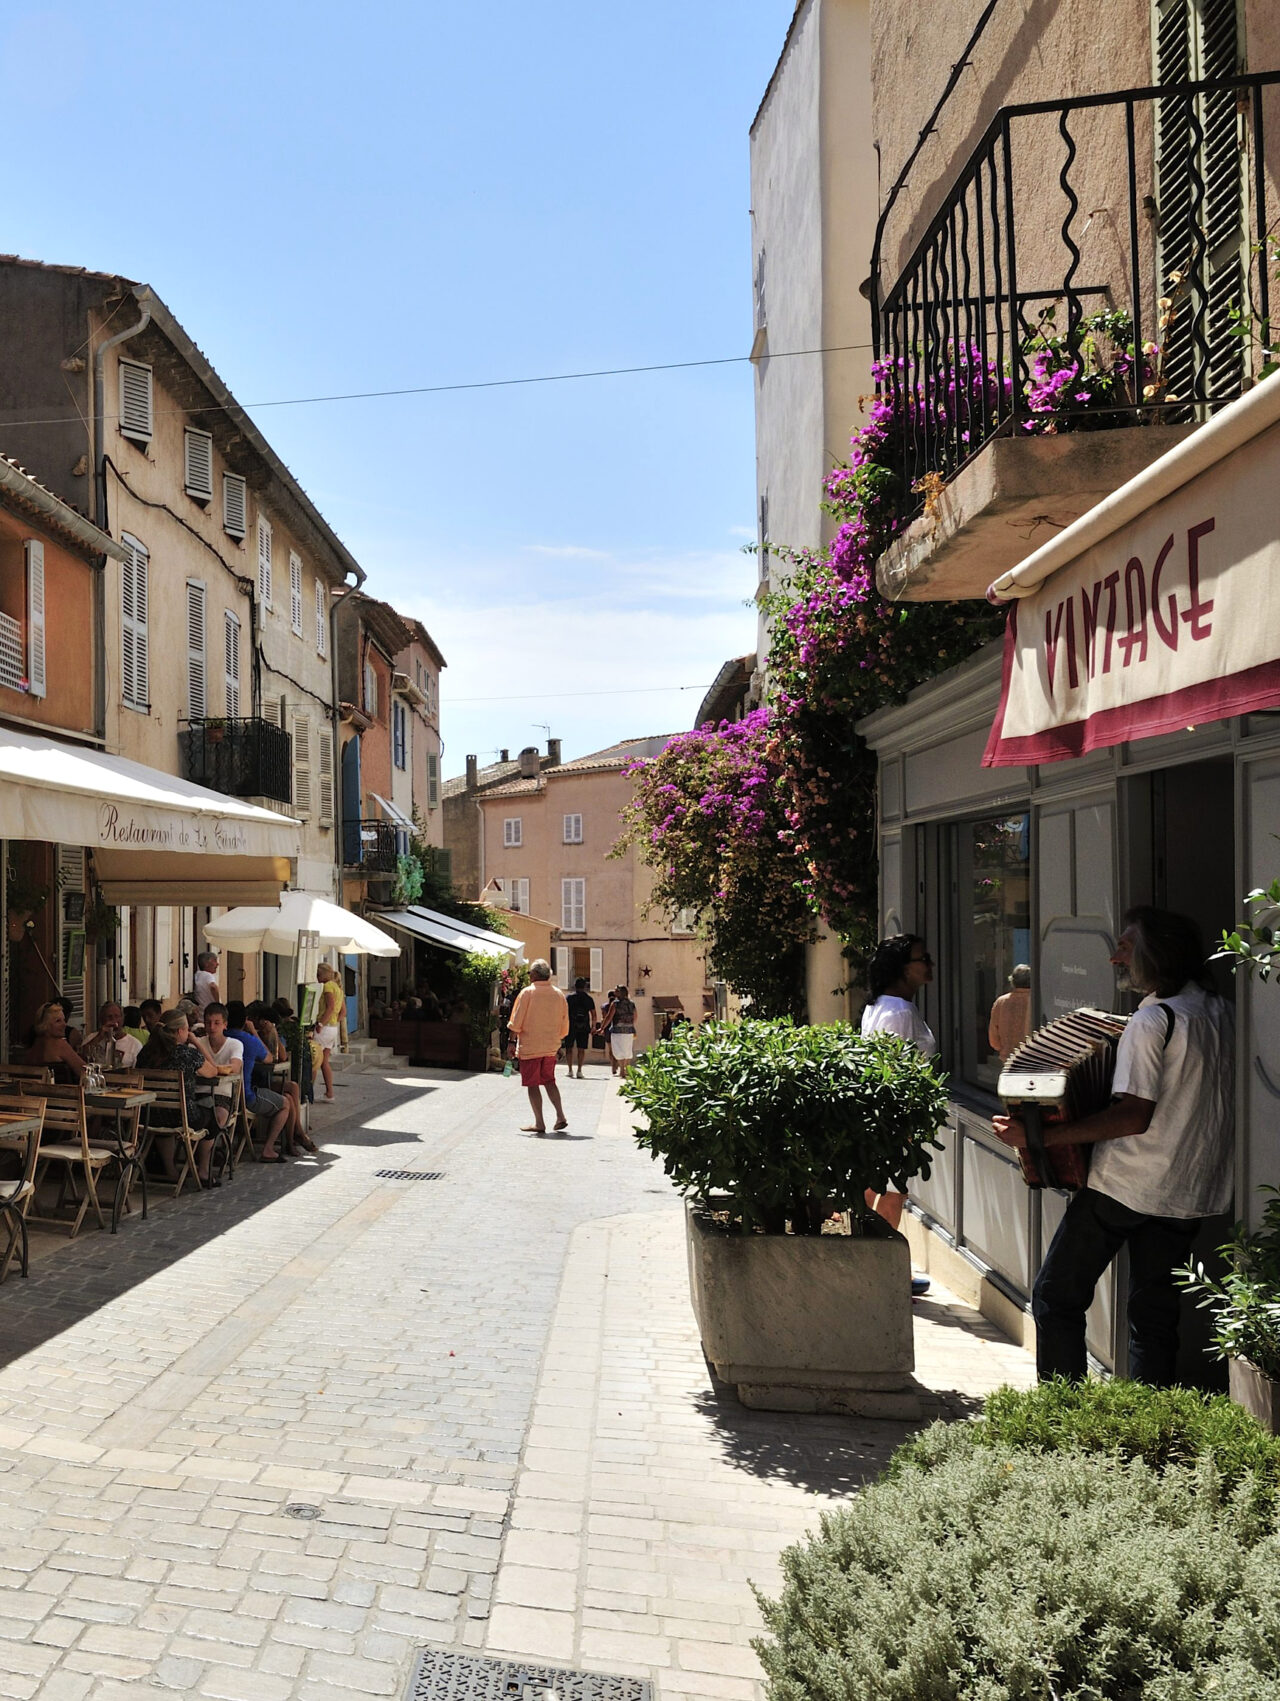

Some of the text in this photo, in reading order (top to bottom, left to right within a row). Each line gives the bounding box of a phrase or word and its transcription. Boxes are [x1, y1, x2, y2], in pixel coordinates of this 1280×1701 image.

[1045, 517, 1216, 697] VINTAGE
[100, 803, 173, 842] Restaurant
[178, 819, 190, 847] de
